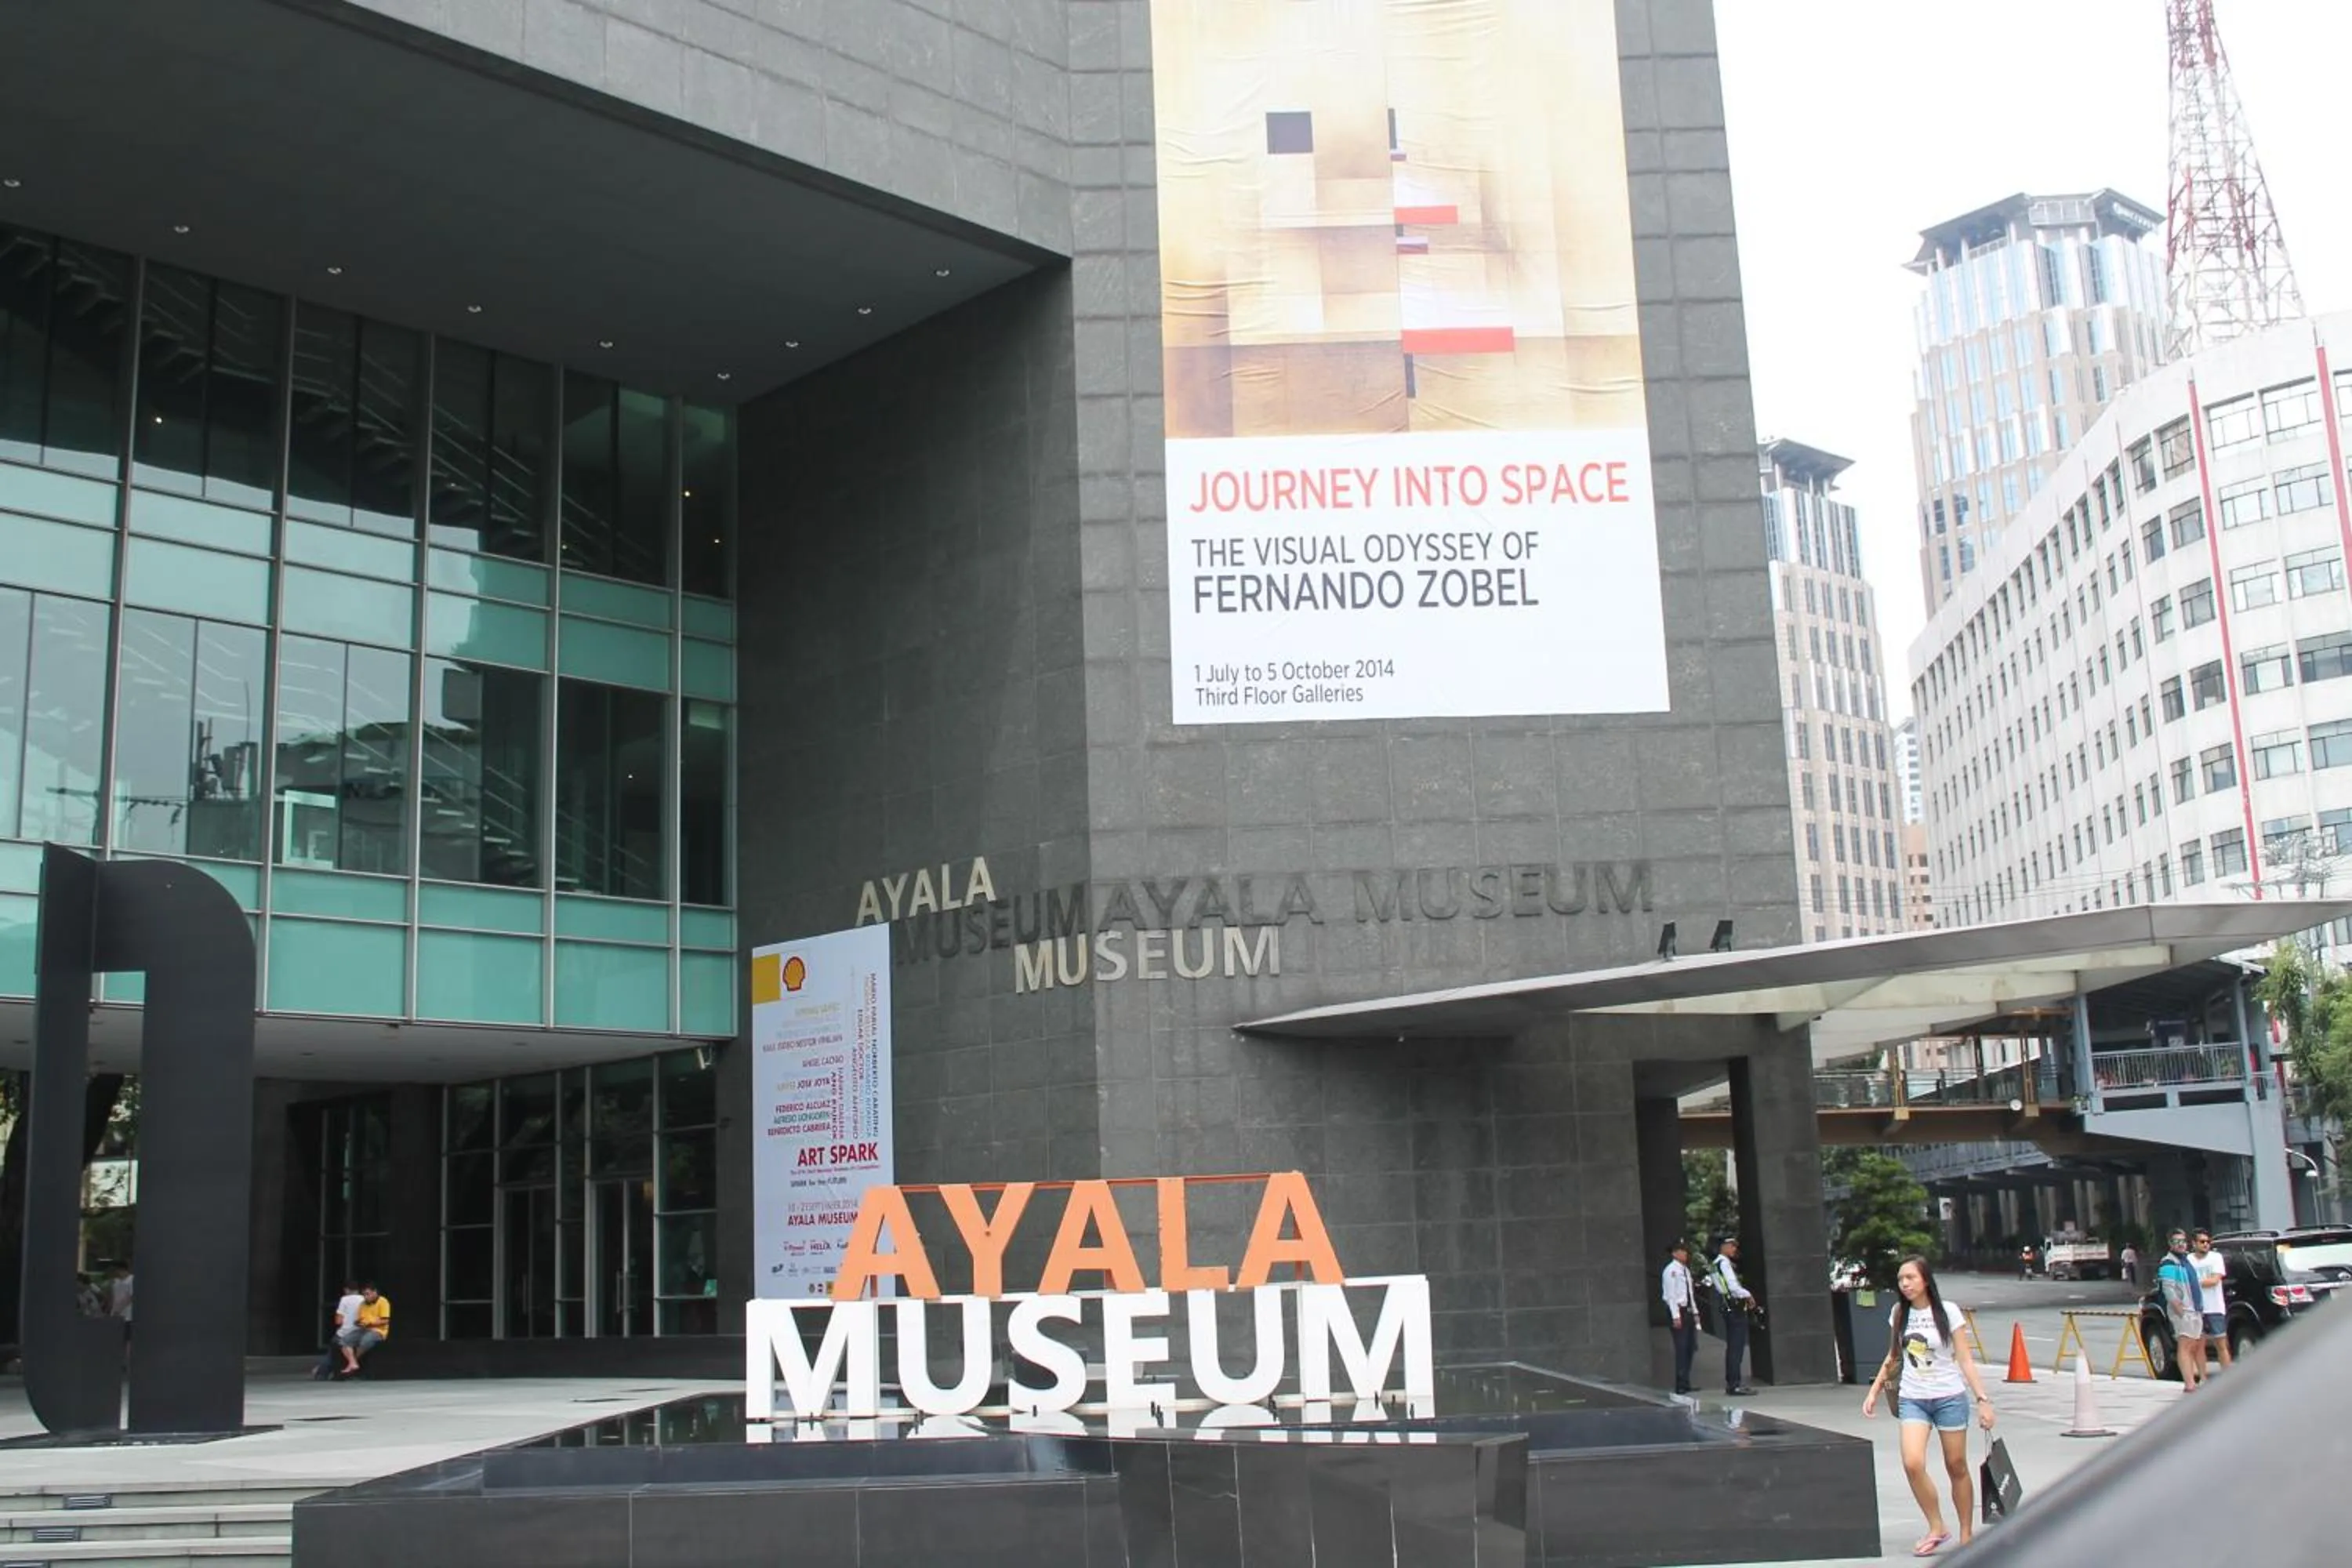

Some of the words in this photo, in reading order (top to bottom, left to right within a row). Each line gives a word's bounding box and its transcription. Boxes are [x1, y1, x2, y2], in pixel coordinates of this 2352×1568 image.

[1189, 467, 1381, 513] JOURNEY
[1393, 464, 1487, 508] INTO
[1501, 461, 1630, 506] SPACE
[1192, 538, 1245, 568] THE
[1254, 535, 1356, 566] VISUAL
[1363, 532, 1494, 564] ODYSSEY
[1502, 530, 1539, 561] OF
[1193, 570, 1405, 614] FERNANDO
[1416, 568, 1540, 609] ZOBEL
[1193, 663, 1203, 684] 1
[1206, 662, 1240, 687] July
[1244, 665, 1261, 683] to
[1267, 663, 1277, 682] 5
[1282, 660, 1350, 682] October
[1355, 659, 1396, 680] 2014
[1196, 687, 1238, 707] Third
[1243, 685, 1287, 706] Floor
[1292, 684, 1364, 705] Galleries
[855, 856, 997, 927] AYALA
[1098, 874, 1325, 931] AYALA
[1352, 862, 1654, 924] MUSEUM
[891, 882, 1088, 966] MUSEUM
[1014, 925, 1280, 994] MUSEUM
[797, 1146, 826, 1167] ART
[829, 1142, 879, 1163] SPARK
[788, 1213, 815, 1226] AYALA
[818, 1210, 859, 1225] MUSEUM
[829, 1171, 1348, 1301] AYALA
[746, 1275, 1435, 1421] MUSEUM
